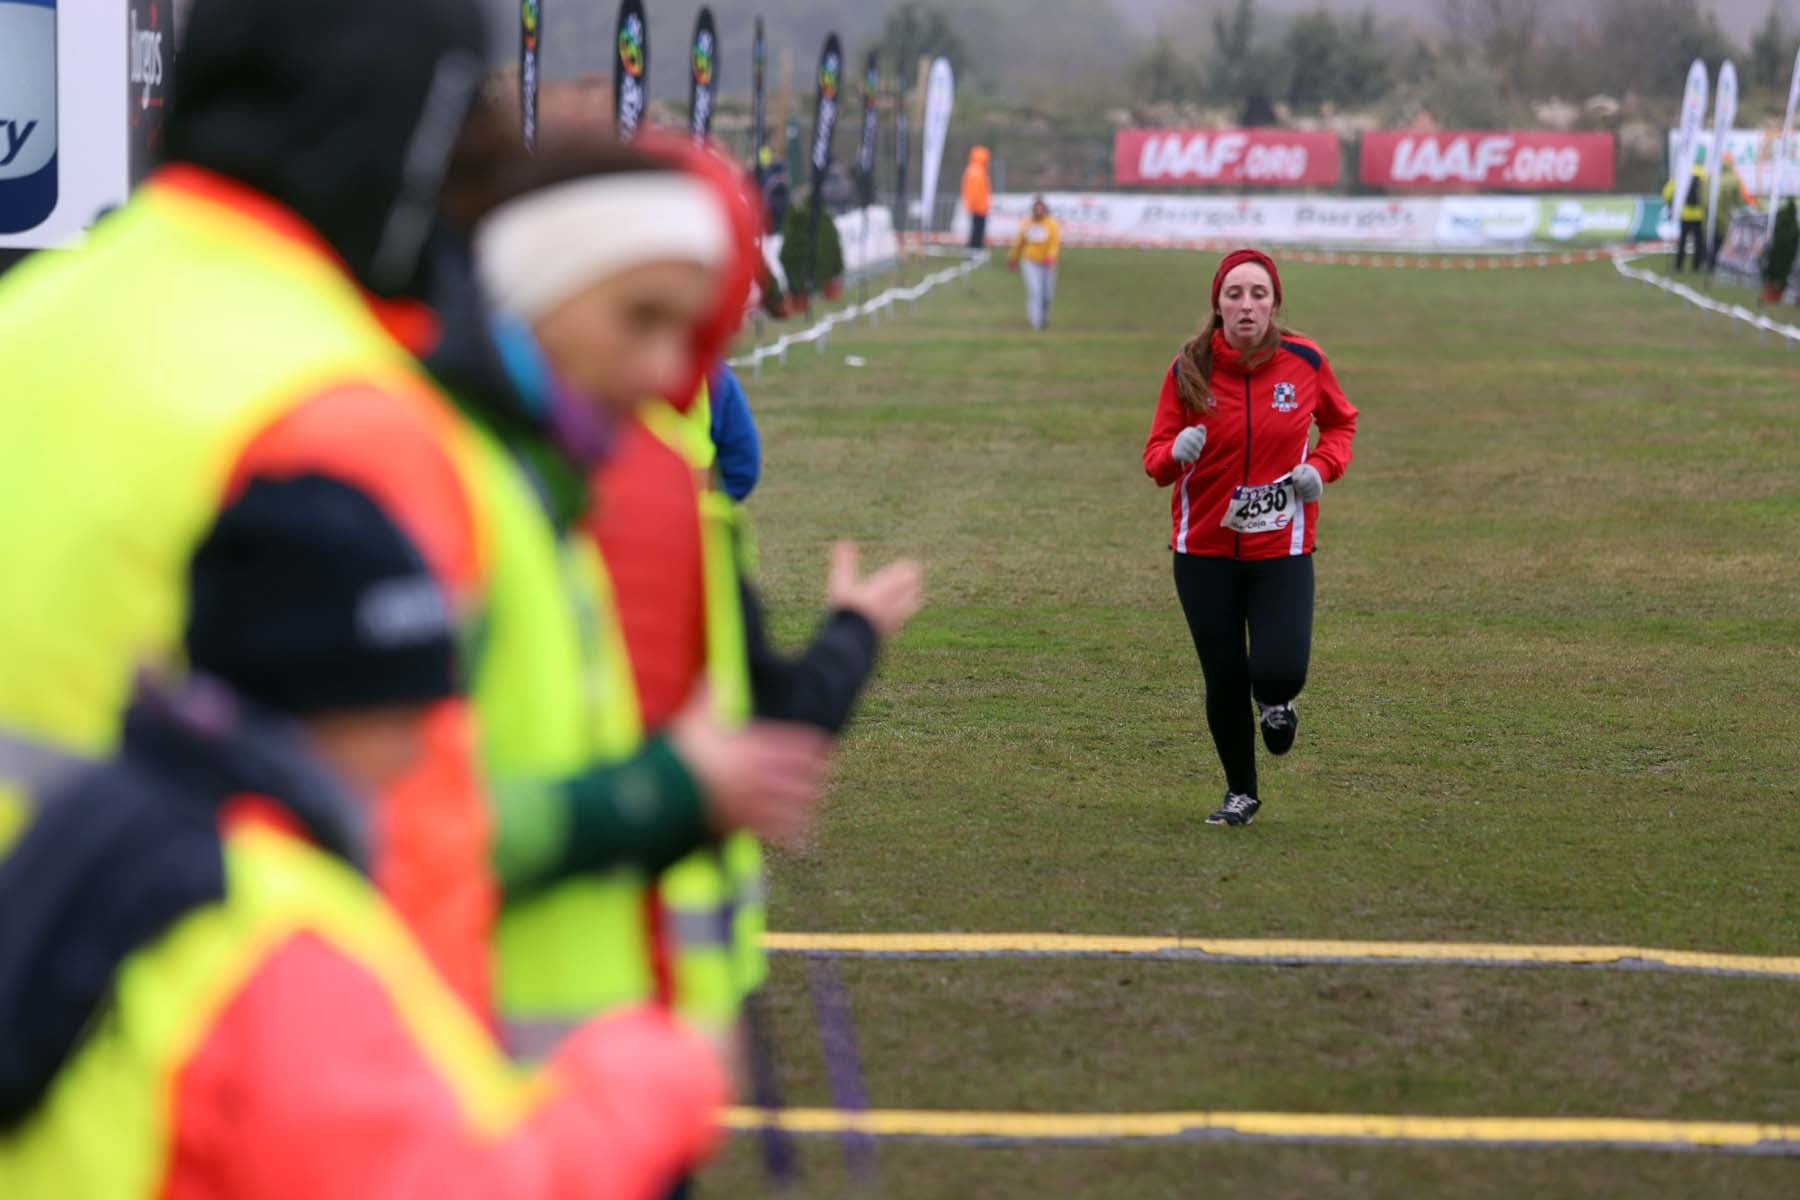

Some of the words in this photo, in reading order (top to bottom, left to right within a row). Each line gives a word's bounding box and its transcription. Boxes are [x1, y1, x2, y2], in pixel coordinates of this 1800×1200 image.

[1139, 132, 1307, 180] IAAF.ORG
[1391, 135, 1579, 182] IAAF.ORG
[1235, 488, 1287, 520] 4530
